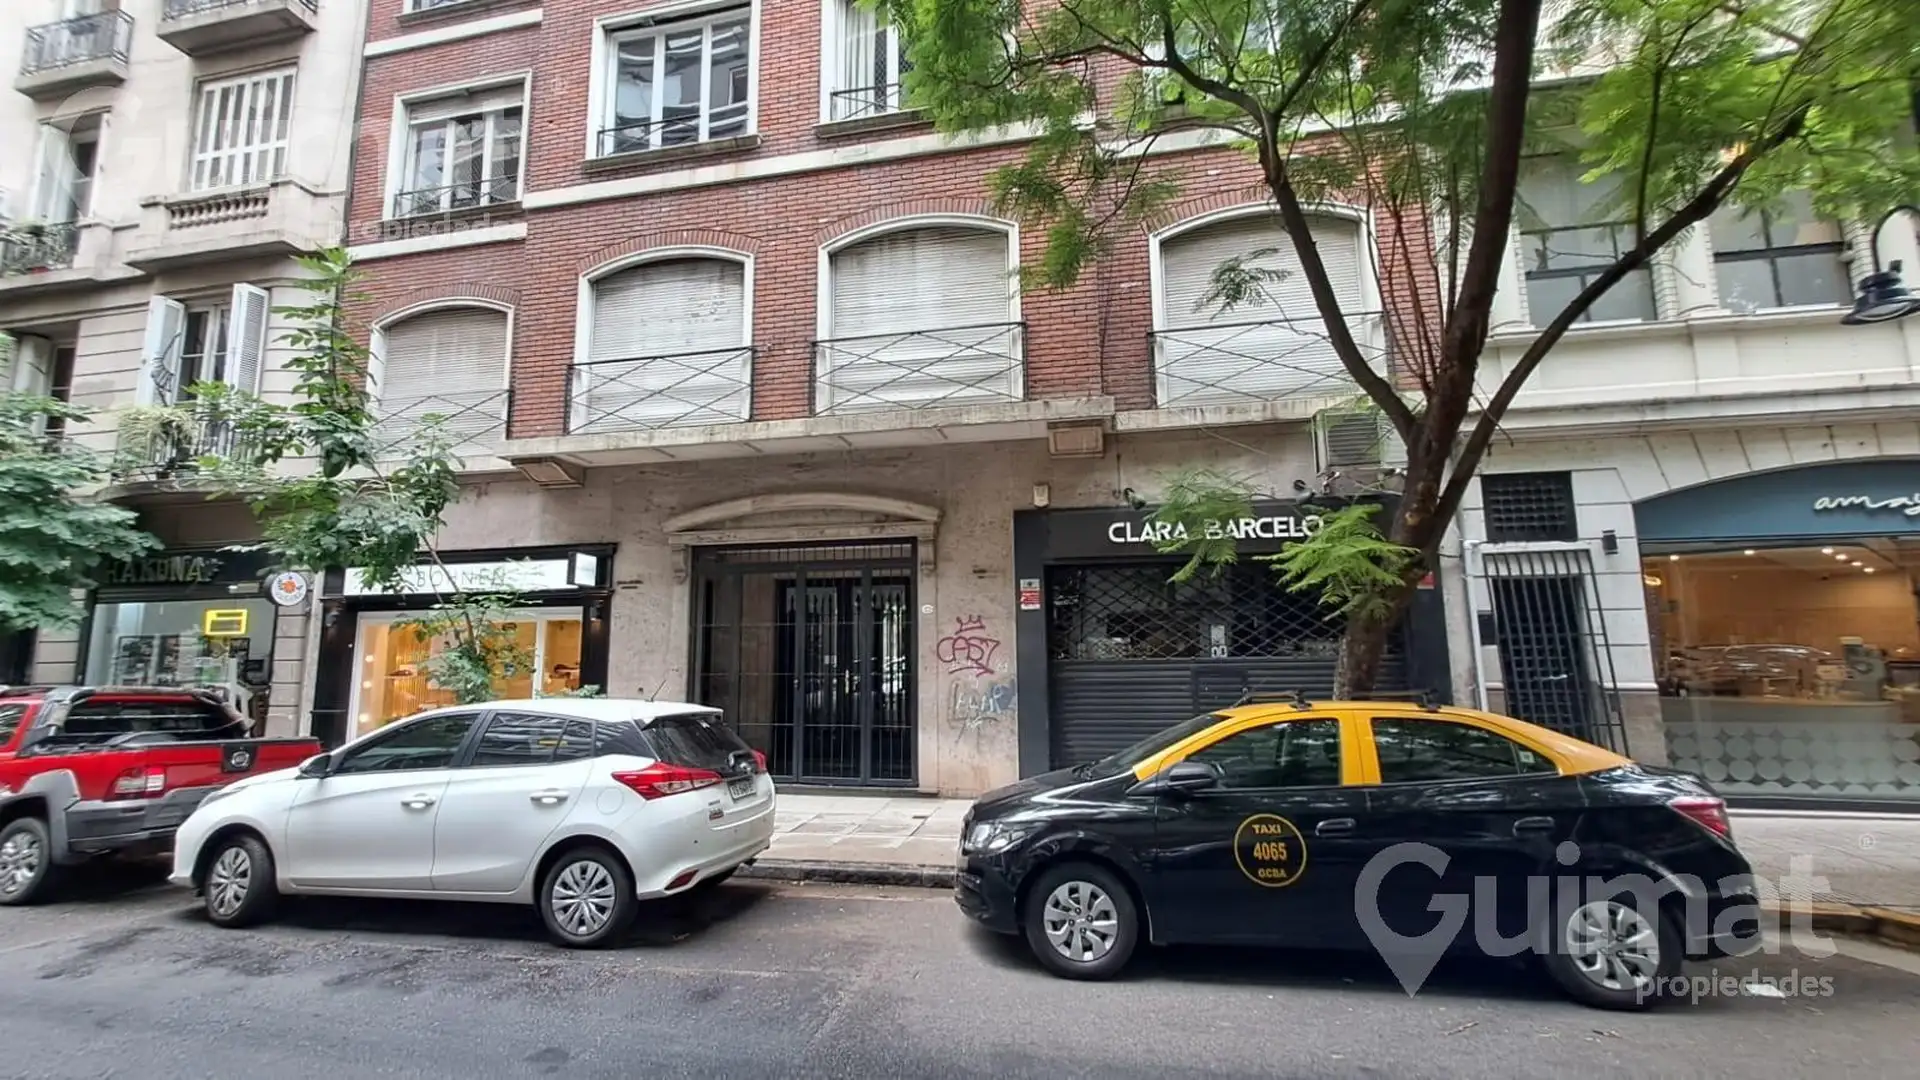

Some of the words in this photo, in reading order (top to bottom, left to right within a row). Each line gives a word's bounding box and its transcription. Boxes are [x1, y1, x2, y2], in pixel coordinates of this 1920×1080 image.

[1107, 520, 1189, 543] CLARA
[1203, 514, 1324, 540] BARCELO
[1251, 823, 1282, 835] TAXI
[1253, 841, 1288, 861] 4065
